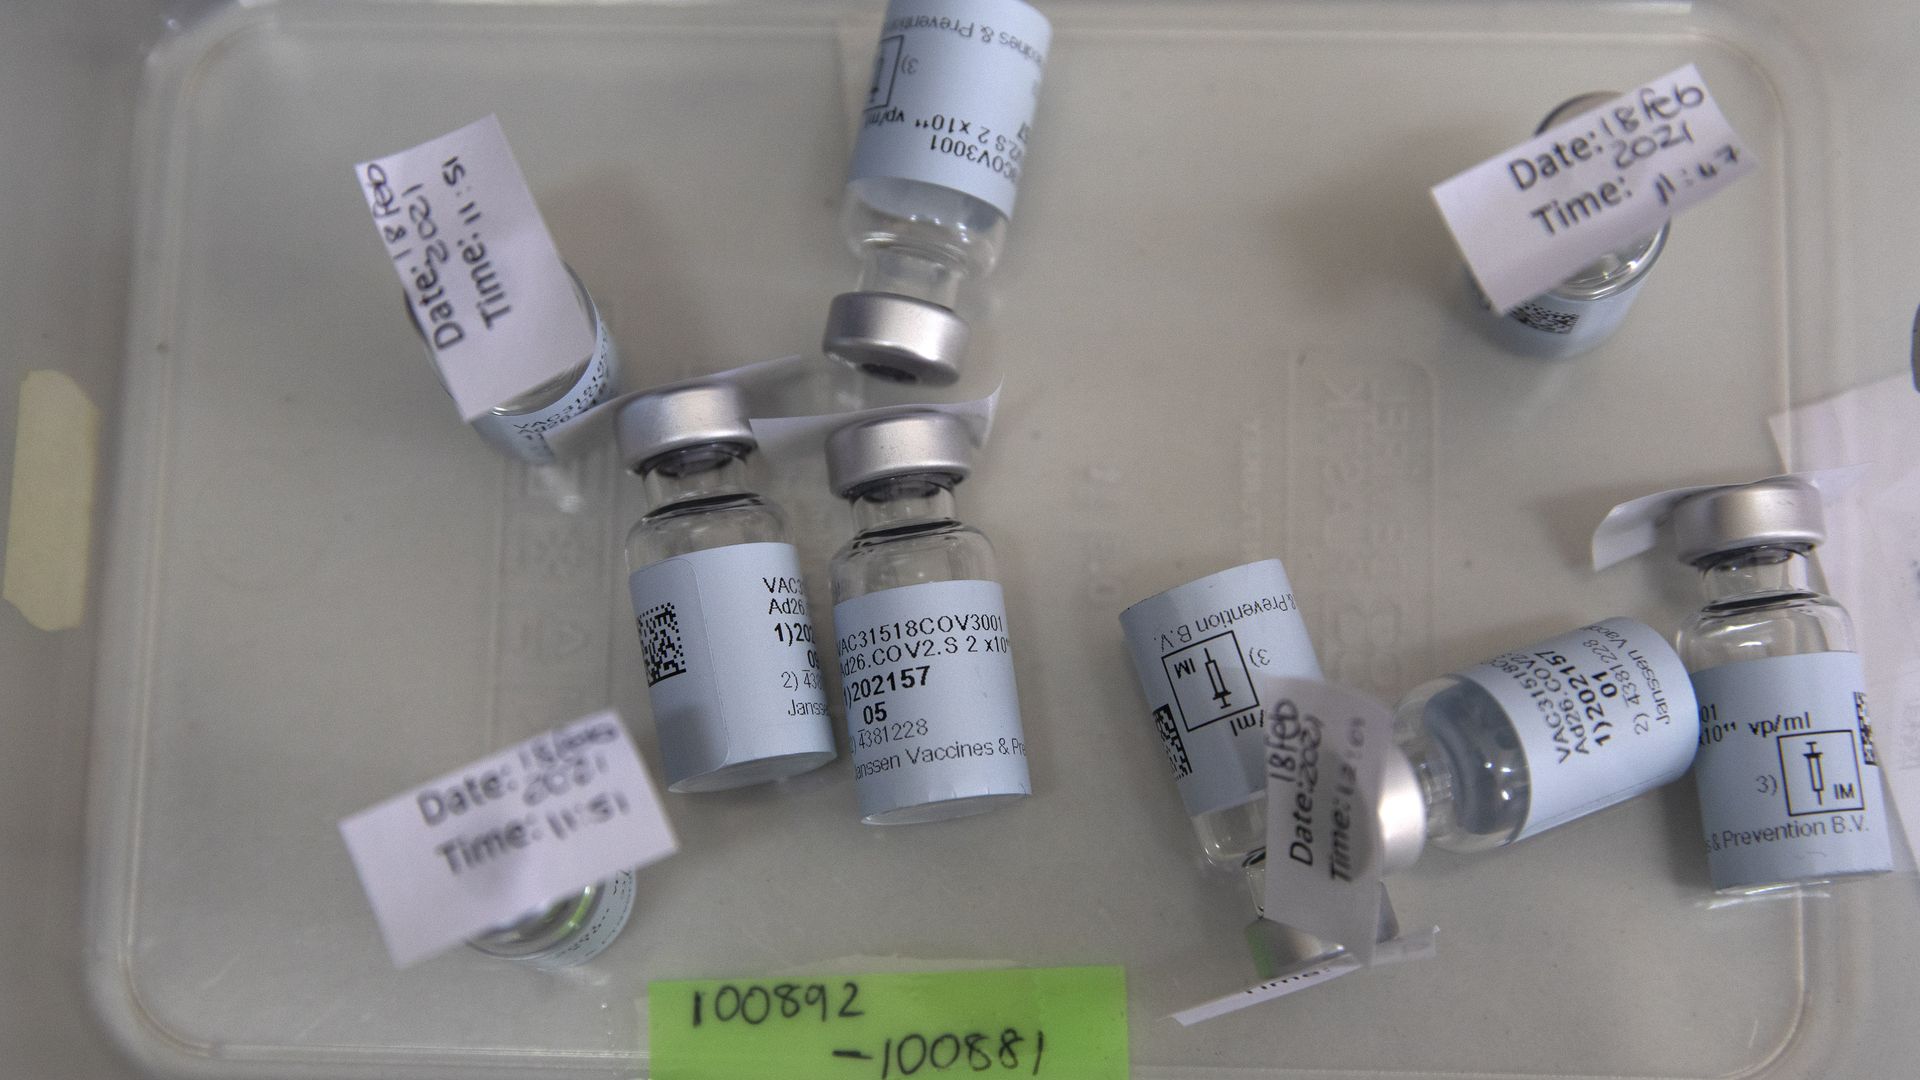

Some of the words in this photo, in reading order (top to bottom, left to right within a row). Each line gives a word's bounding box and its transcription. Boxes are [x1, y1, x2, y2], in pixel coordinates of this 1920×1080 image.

[979, 27, 995, 43] &
[900, 54, 919, 75] 3)
[977, 126, 991, 145] 2
[1611, 121, 1695, 169] 2021
[1508, 130, 1604, 190] Date:
[1530, 176, 1633, 236] Time:
[456, 232, 512, 331] Time:
[411, 264, 465, 350] Date:
[1194, 593, 1291, 633] Prevention
[965, 635, 979, 653] 2
[1152, 624, 1193, 653] B.V.
[1173, 657, 1197, 680] IM
[1248, 647, 1271, 669] 3)
[780, 671, 799, 692] 2)
[1591, 671, 1618, 699] 01
[1628, 649, 1671, 725] Janssen
[862, 701, 888, 725] 05
[1534, 650, 1613, 747] 1)202157
[857, 718, 929, 750] 4381228
[1633, 712, 1651, 736] 2)
[1748, 711, 1812, 738] vp/ml
[904, 741, 995, 766] Vaccines
[998, 737, 1010, 756] &
[415, 765, 520, 829] Date:
[1755, 775, 1777, 797] 3)
[1833, 783, 1855, 800] IM
[1289, 779, 1314, 867] Date:
[1722, 819, 1827, 848] Prevention
[1831, 815, 1870, 835] B.V.
[436, 811, 544, 875] Time:
[1329, 799, 1356, 884] Time:
[692, 982, 865, 1028] 100892
